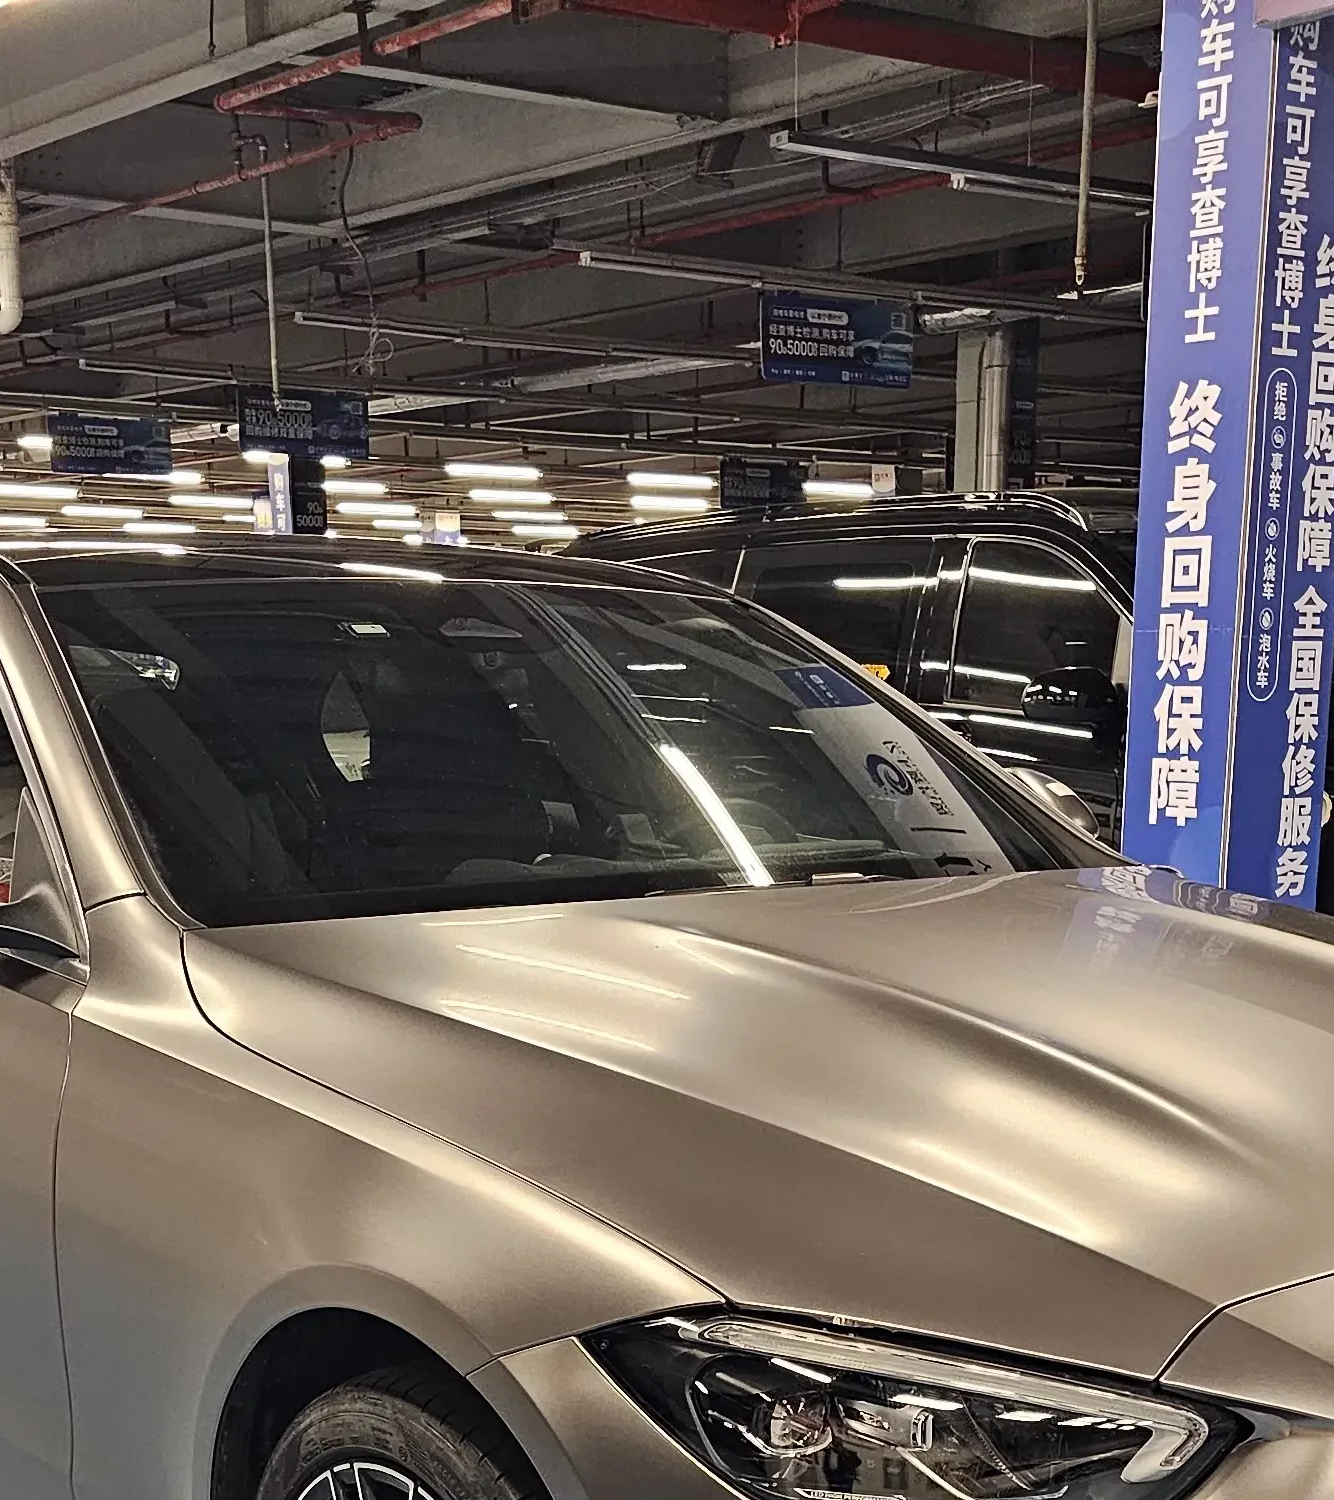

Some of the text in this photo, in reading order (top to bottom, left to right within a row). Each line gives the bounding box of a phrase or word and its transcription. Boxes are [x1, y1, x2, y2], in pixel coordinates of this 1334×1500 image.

[1148, 379, 1222, 826] 终身回购保障
[1256, 382, 1288, 689] 拒绝 事故车 火烧车 泡水车
[1275, 585, 1328, 898] 全国保修服务
